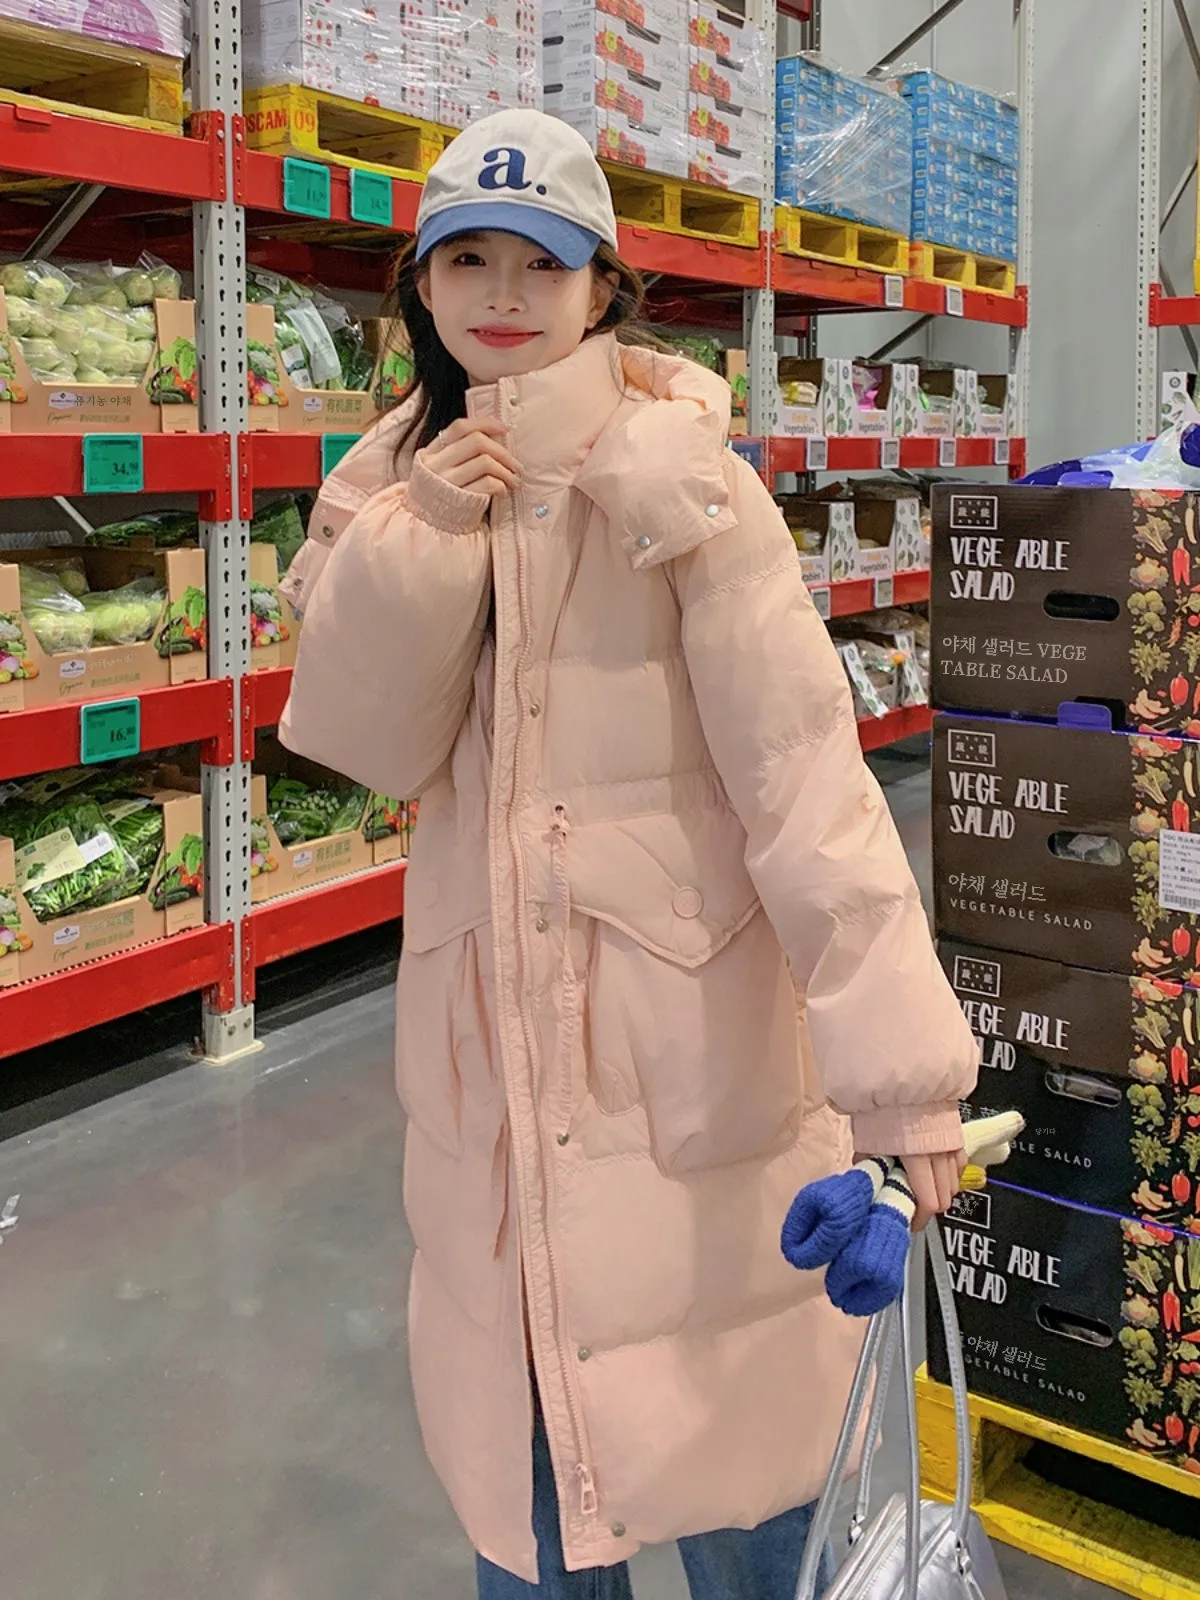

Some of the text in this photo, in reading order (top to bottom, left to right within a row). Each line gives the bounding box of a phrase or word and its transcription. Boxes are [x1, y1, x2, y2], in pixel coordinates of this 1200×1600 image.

[75, 394, 107, 407] 유기농
[110, 394, 132, 407] 야채
[950, 536, 1070, 571] VEGE ABLE
[949, 570, 1015, 602] SALAD
[943, 634, 1087, 661] 야채 샐러드 VEGE
[941, 659, 1068, 684] TABLE SALAD
[948, 771, 1070, 814] VEGE ABLE
[949, 806, 1016, 840] SALAD
[949, 871, 1047, 903] 야채 샐러드
[950, 898, 1093, 931] VEGETABLE SALAD
[1016, 1011, 1071, 1051] ABLE
[977, 1037, 1016, 1072] LAD
[1044, 1146, 1093, 1169] SALAD
[943, 1226, 1061, 1288] VEGE ABLE
[967, 1335, 1047, 1371] 야채 샐러드
[965, 1356, 1086, 1403] GETABLE SALAD
